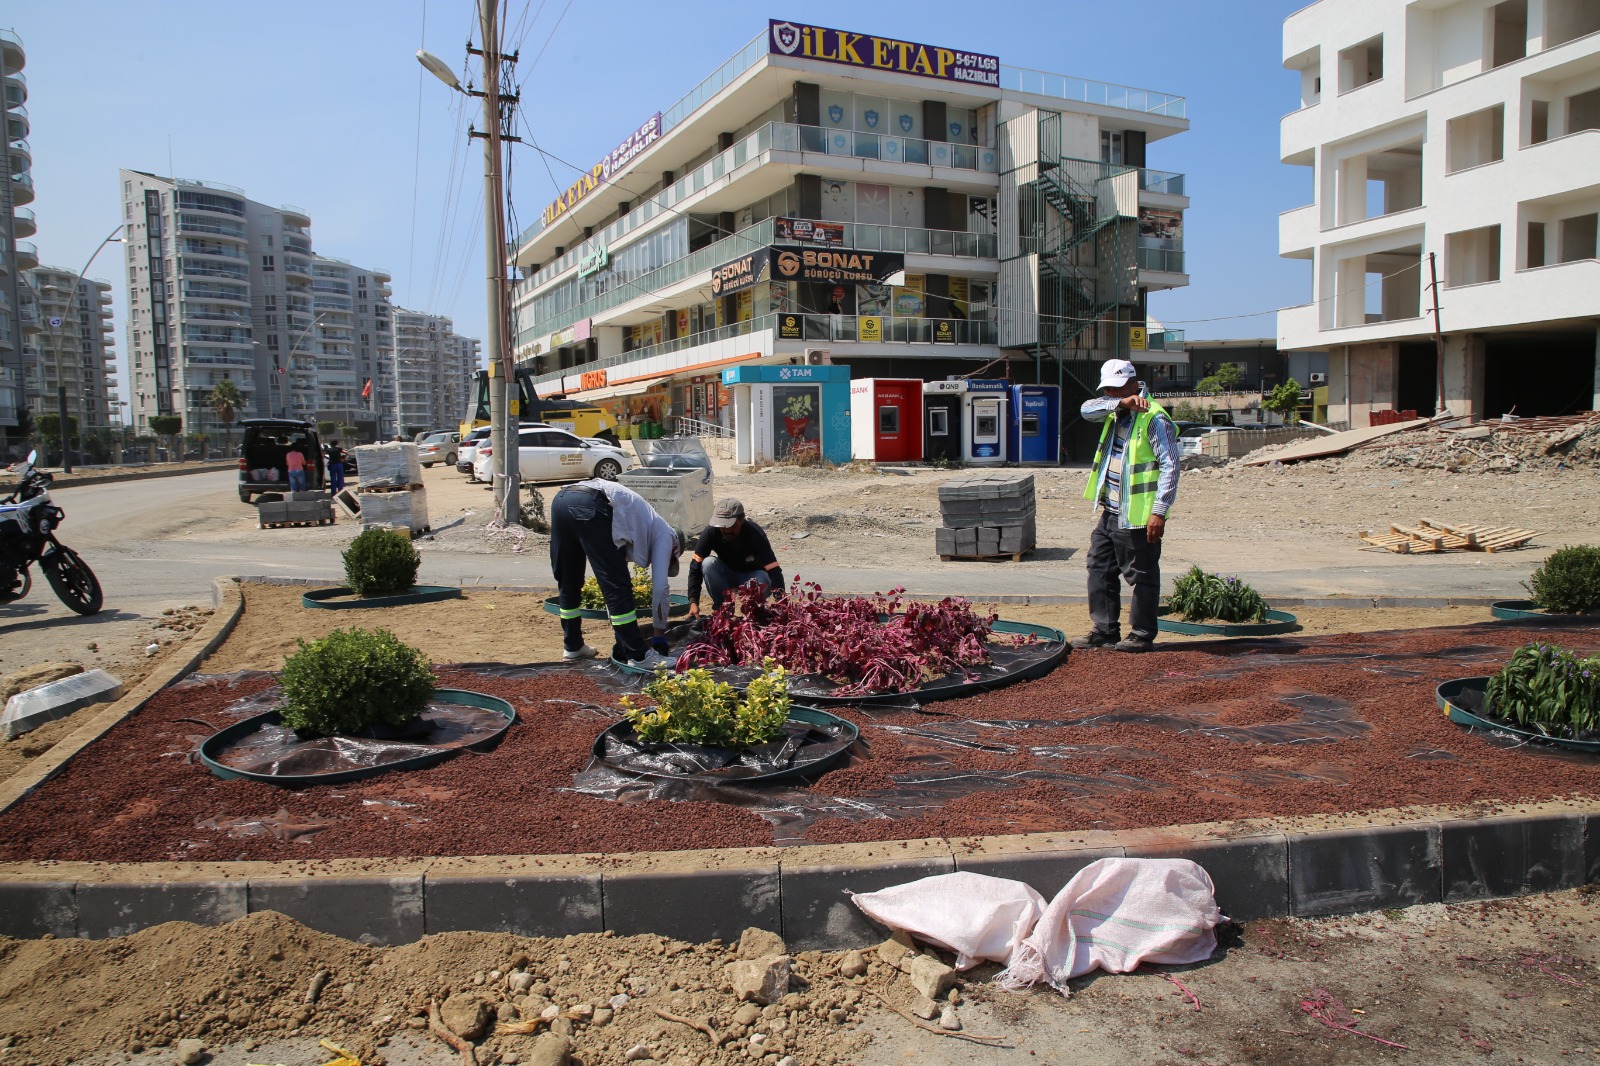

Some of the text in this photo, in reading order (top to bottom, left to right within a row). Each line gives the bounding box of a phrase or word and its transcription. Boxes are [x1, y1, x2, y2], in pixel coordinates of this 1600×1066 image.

[870, 36, 955, 78] ETAP
[978, 57, 997, 71] LGS
[954, 67, 998, 85] HAZIRLIK
[635, 117, 657, 142] LGS
[611, 129, 659, 173] HAZIRLIK
[568, 163, 602, 207] ETAP
[721, 257, 753, 280] SONAT
[803, 251, 874, 270] SONAT
[804, 268, 873, 281] SÜRÜCÜ KURSU
[792, 368, 812, 377] TAM
